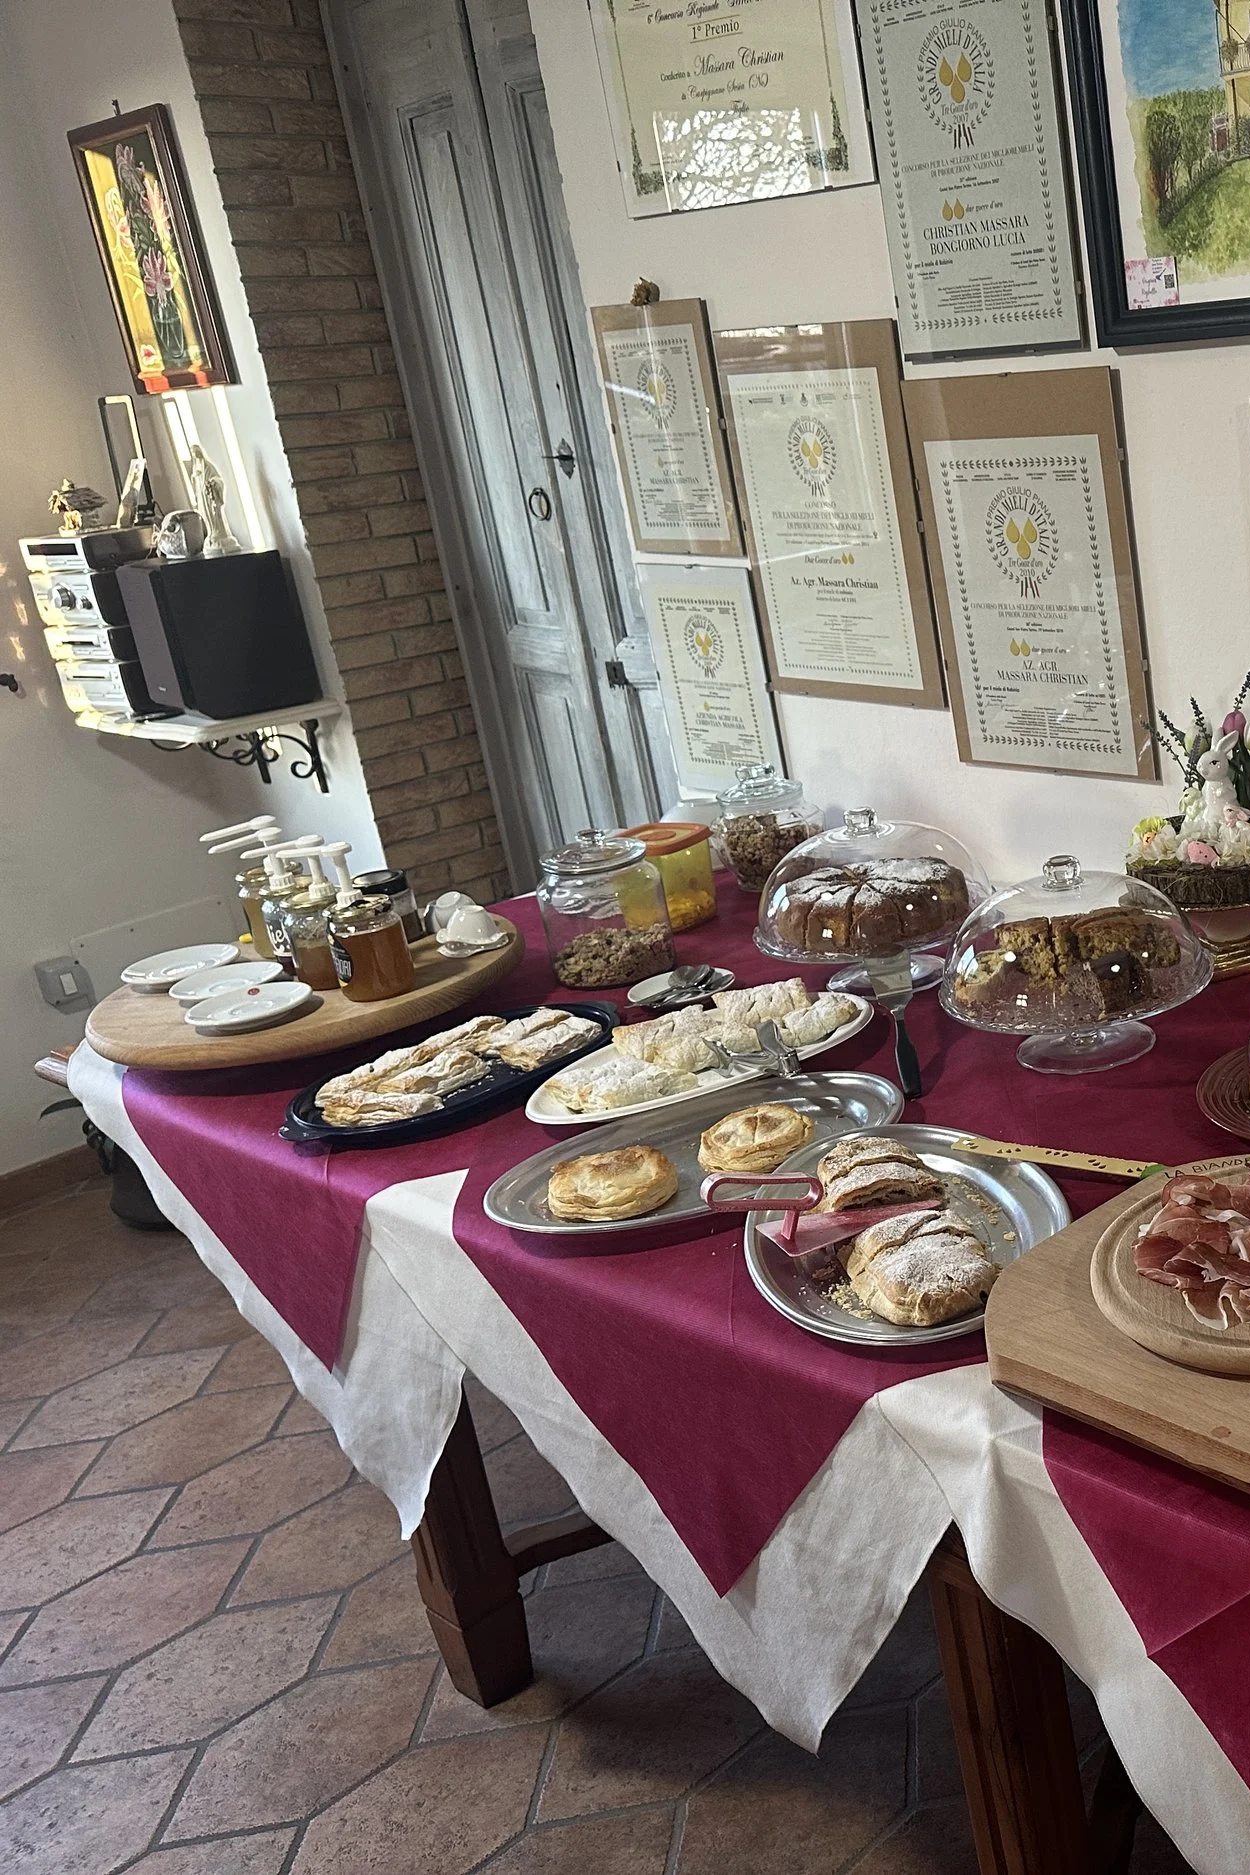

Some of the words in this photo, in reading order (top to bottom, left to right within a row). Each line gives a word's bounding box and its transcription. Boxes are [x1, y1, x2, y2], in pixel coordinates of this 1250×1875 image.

[705, 20, 740, 37] Premio
[939, 17, 966, 31] GIULIO
[966, 22, 987, 50] PIANA
[693, 54, 735, 76] Massara
[737, 46, 785, 68] Christian
[925, 49, 943, 105] GRANDI
[934, 29, 962, 55] MIELI
[923, 221, 978, 241] CHRISTIAN
[980, 214, 1030, 233] MASSARA
[930, 235, 991, 256] BONGIORNO
[993, 231, 1027, 247] LUCIA
[986, 489, 1006, 519] PREMIO
[1006, 485, 1032, 498] GIULIO
[1032, 493, 1051, 521] PIANA
[993, 508, 1009, 557] GRANDI
[1001, 495, 1029, 516] MIELI
[818, 576, 845, 588] Massara
[845, 577, 879, 590] Christian
[1019, 569, 1035, 577] 2010
[997, 670, 1037, 683] MASSARA
[1040, 672, 1089, 685] CHRISTIAN
[1164, 1169, 1185, 1179] LA
